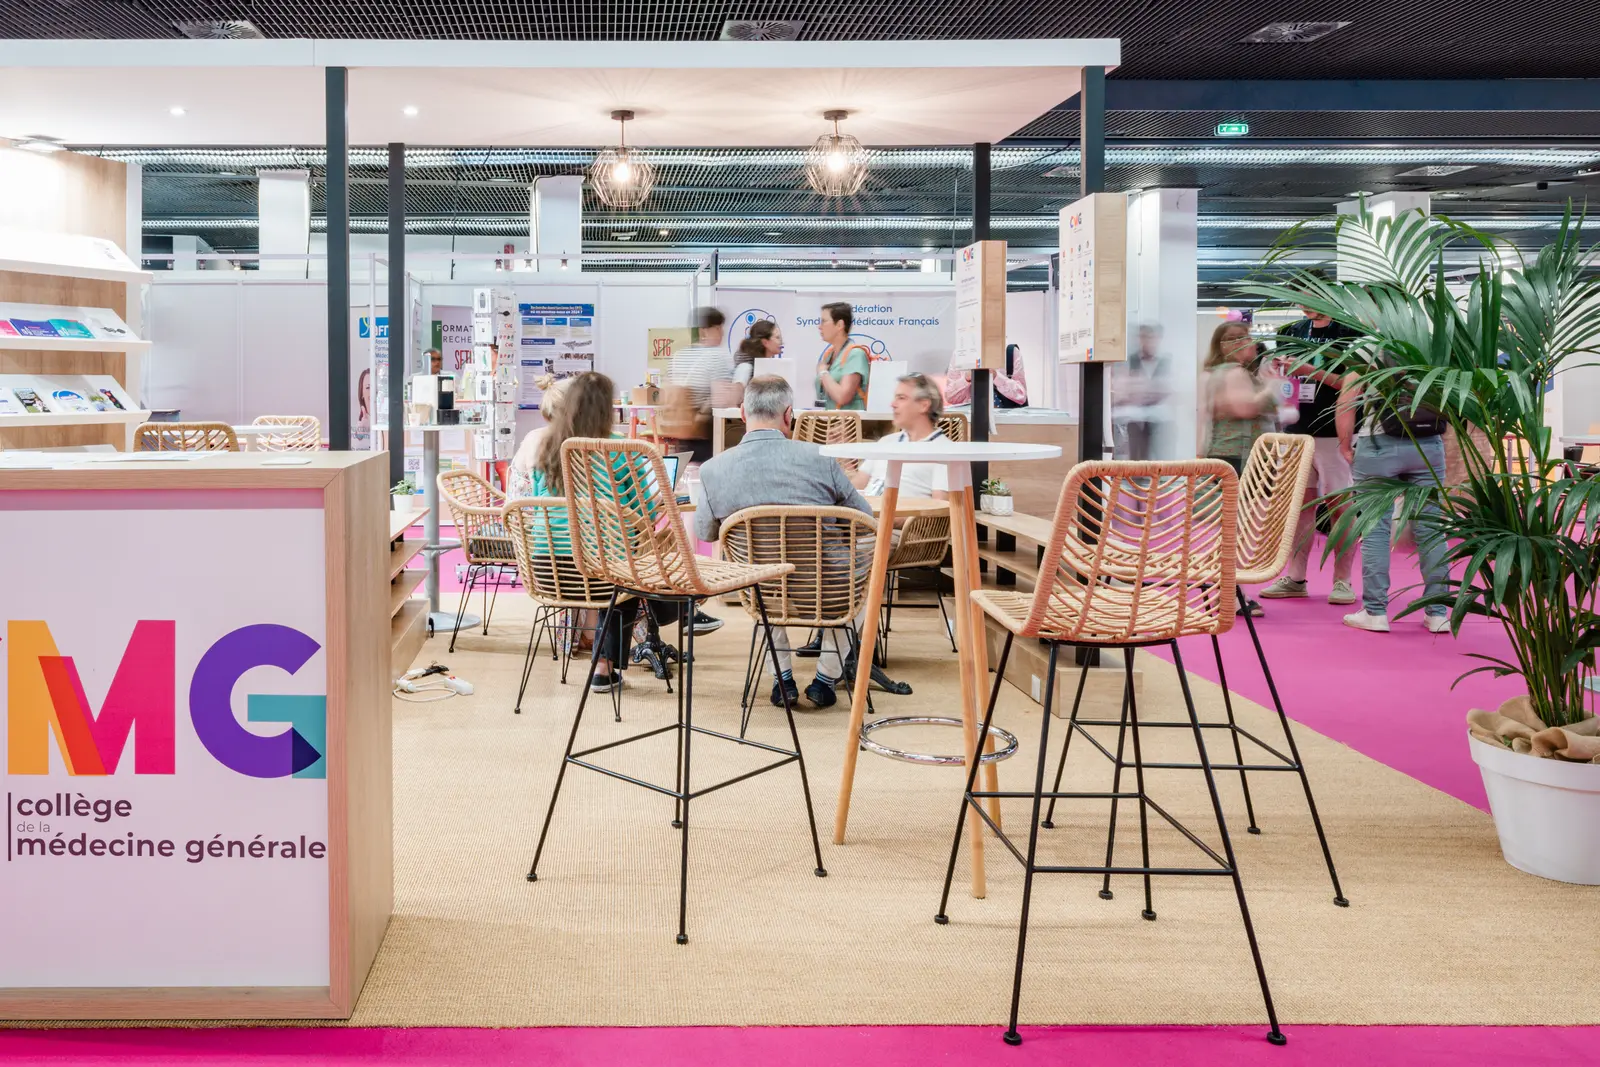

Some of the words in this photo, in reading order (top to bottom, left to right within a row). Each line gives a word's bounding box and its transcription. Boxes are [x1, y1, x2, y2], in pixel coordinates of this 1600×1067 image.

[851, 304, 893, 313] dération
[898, 317, 940, 328] Français
[436, 324, 474, 333] FORMAT
[443, 335, 472, 344] RECHE
[0, 619, 327, 780] MG
[16, 792, 133, 823] collège
[16, 821, 35, 833] de
[39, 821, 51, 833] la
[16, 831, 176, 859] médecine
[185, 834, 327, 863] générale
